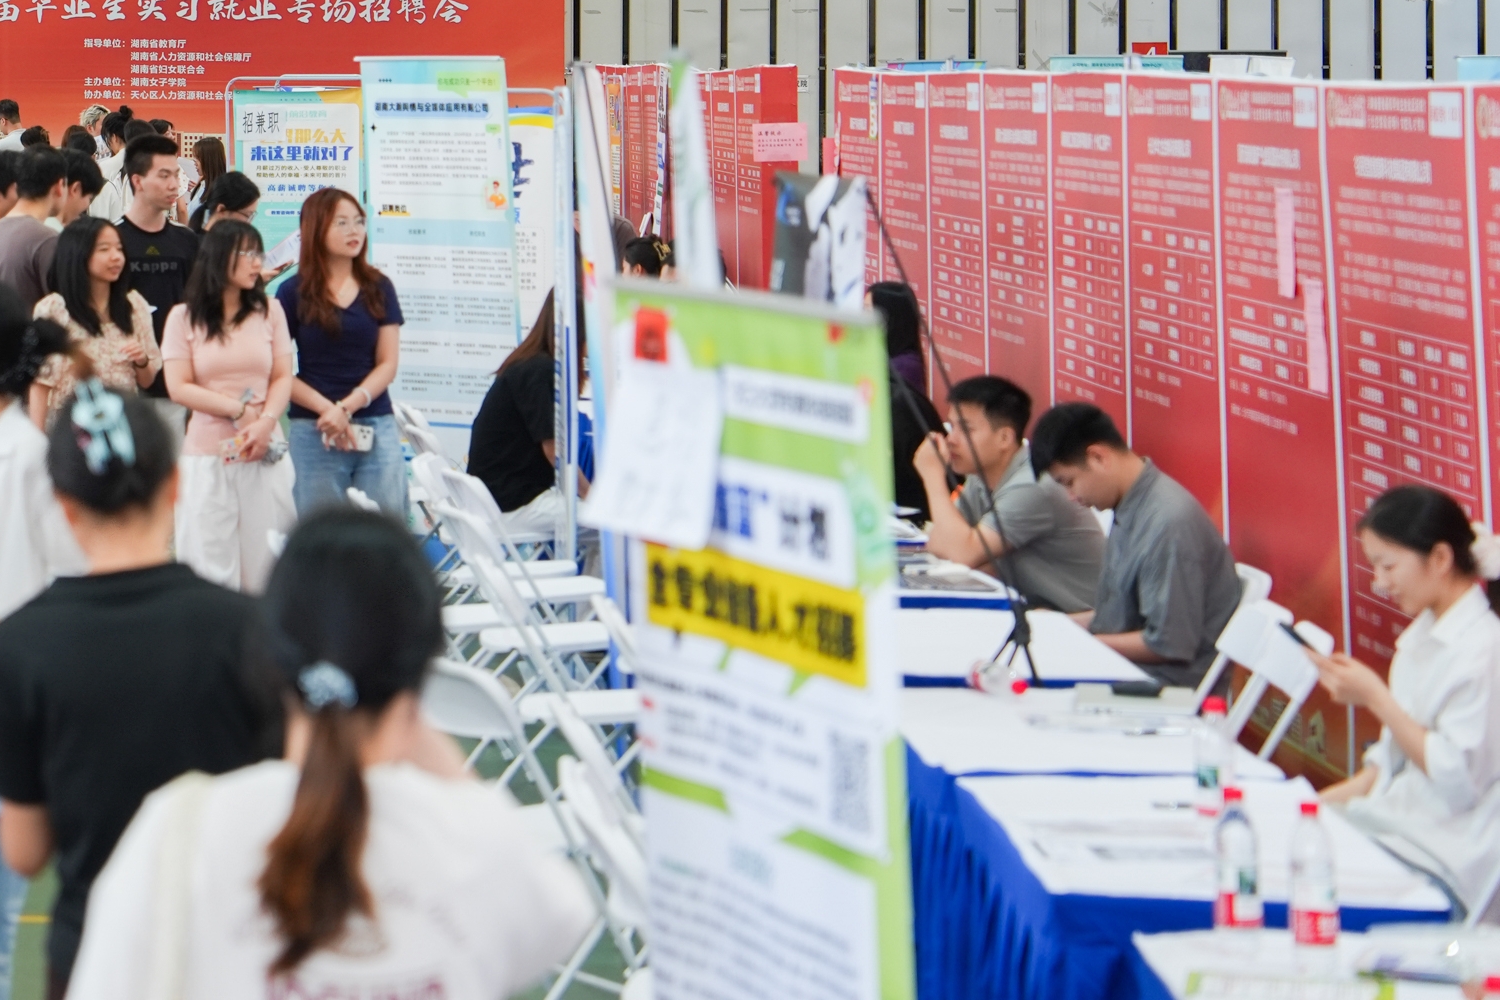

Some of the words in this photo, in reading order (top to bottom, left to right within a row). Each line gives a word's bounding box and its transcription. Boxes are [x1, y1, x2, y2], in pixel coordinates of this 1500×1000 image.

[130, 52, 252, 62] 湖南省人力资源和社会保障厅
[130, 65, 205, 75] 湖南省妇女联合会
[242, 111, 280, 134] 招兼职
[250, 145, 354, 161] 来这里就对了
[130, 261, 178, 273] Kappa
